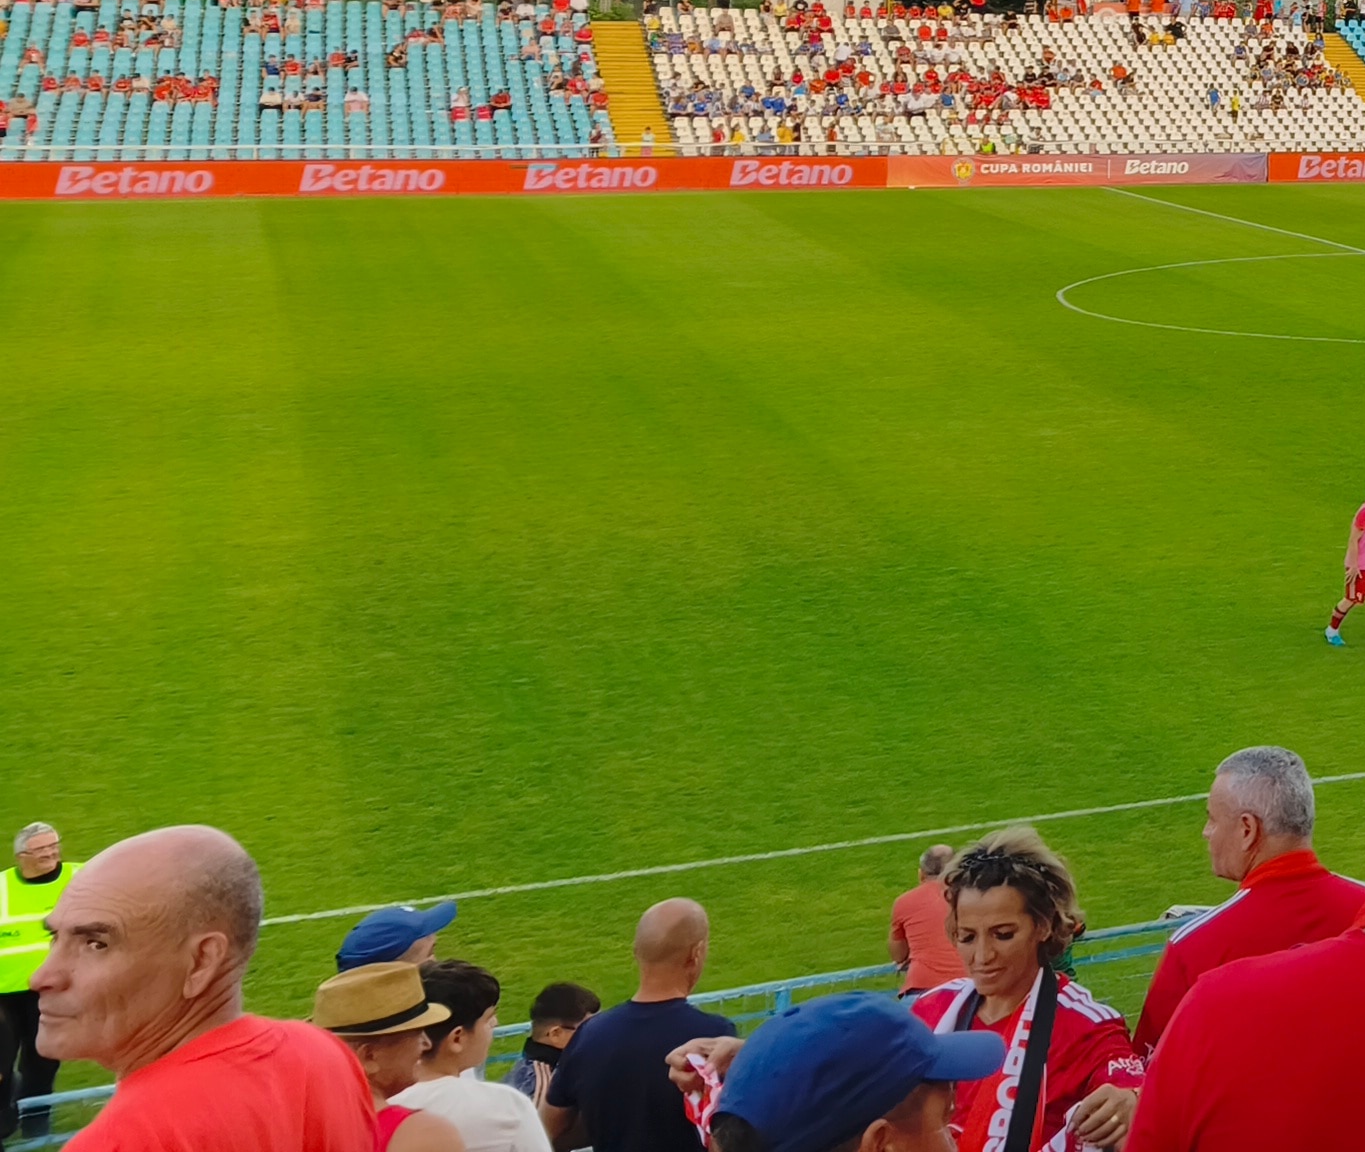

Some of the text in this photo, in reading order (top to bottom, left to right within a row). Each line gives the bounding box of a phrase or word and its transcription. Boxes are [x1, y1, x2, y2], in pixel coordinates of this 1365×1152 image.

[55, 165, 213, 195] Betano
[301, 164, 444, 193] Betano
[524, 163, 657, 190] Betano
[729, 160, 852, 186] Betano
[980, 158, 1189, 175] CUPA ROMÂNIEI Betano
